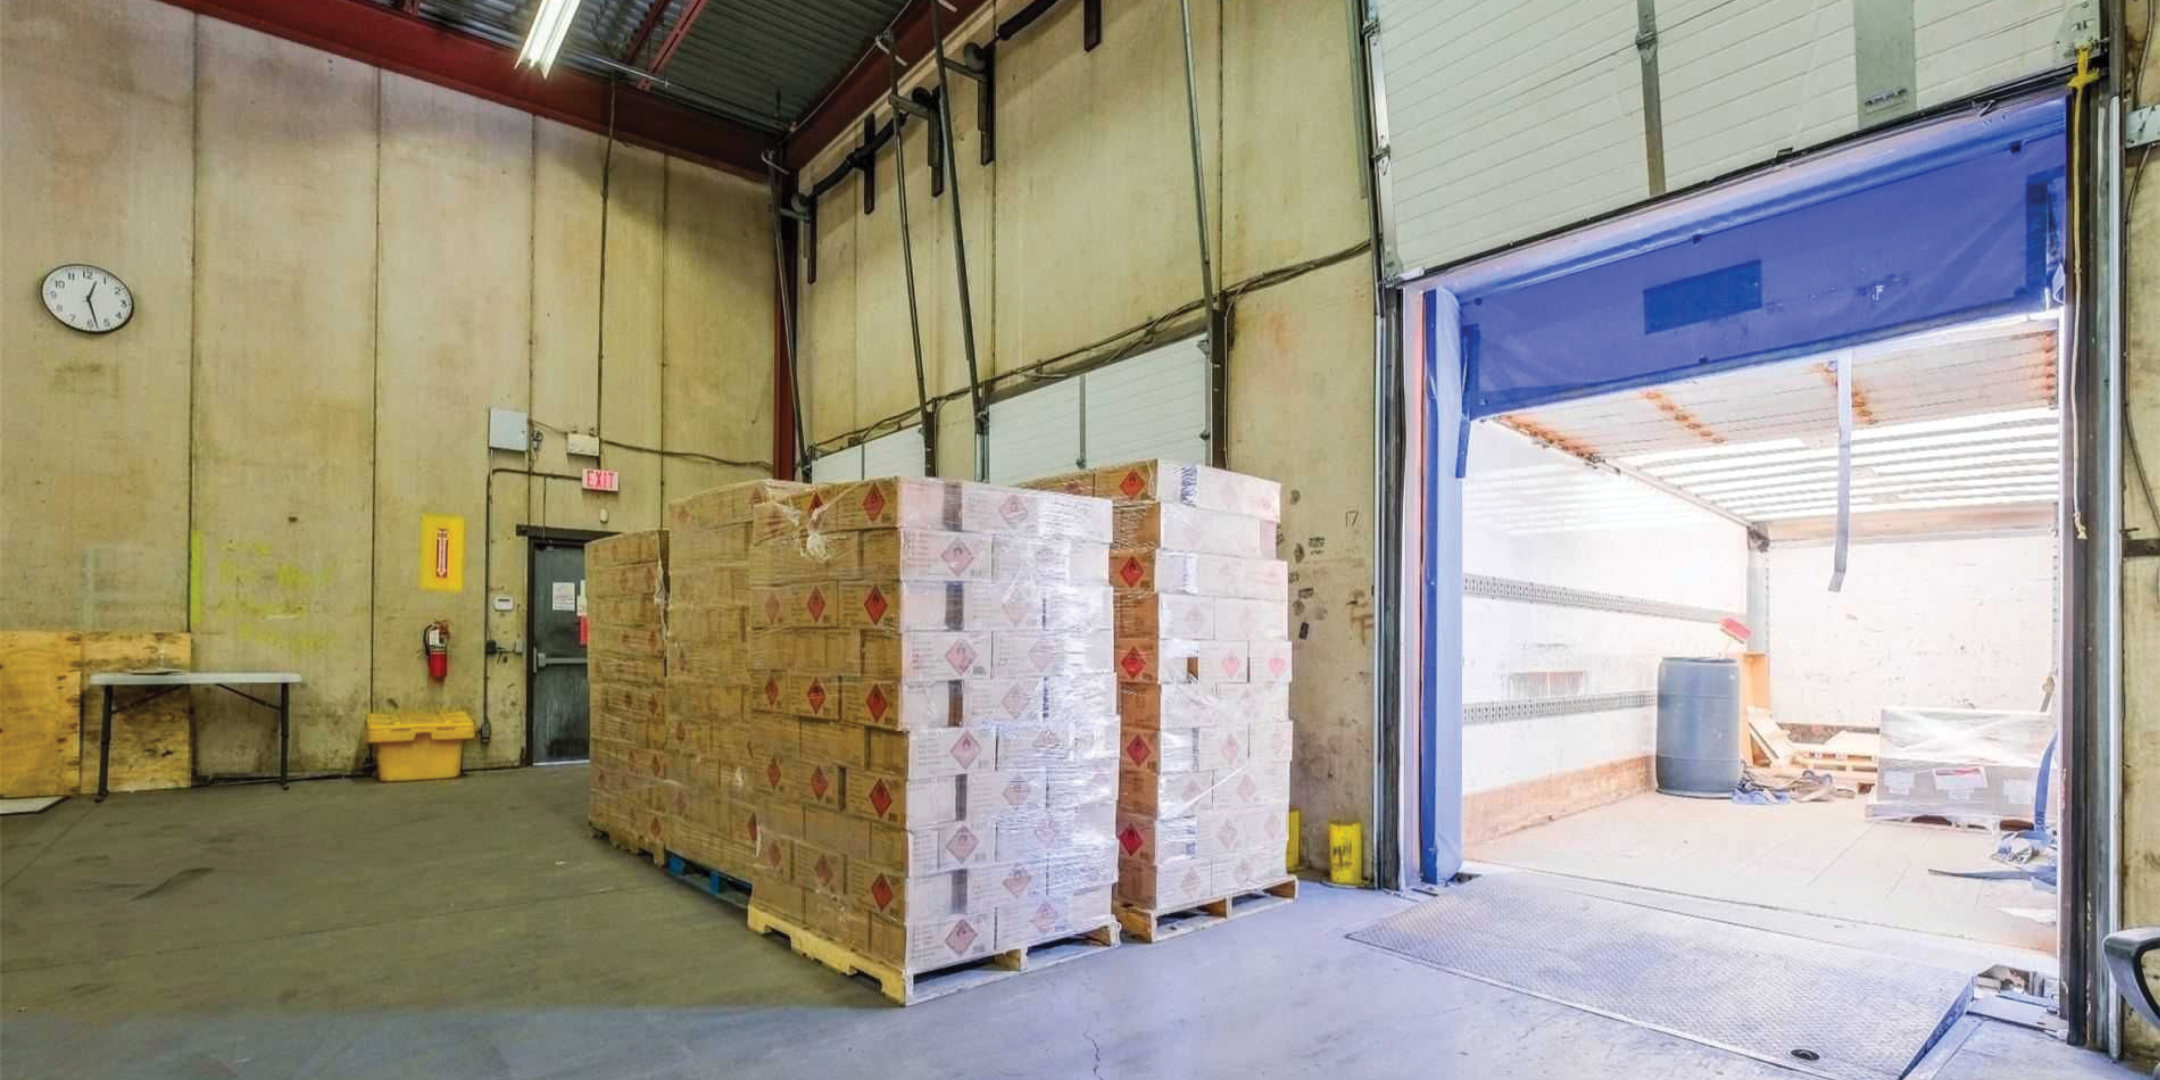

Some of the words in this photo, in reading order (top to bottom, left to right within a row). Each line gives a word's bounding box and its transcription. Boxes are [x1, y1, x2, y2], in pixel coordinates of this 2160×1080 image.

[68, 272, 75, 281] 11
[82, 270, 93, 280] 12
[55, 280, 66, 288] 10
[103, 277, 107, 285] 1
[114, 287, 121, 295] 2
[121, 300, 128, 308] 3
[103, 319, 110, 327] 5
[587, 470, 614, 489] EXIT
